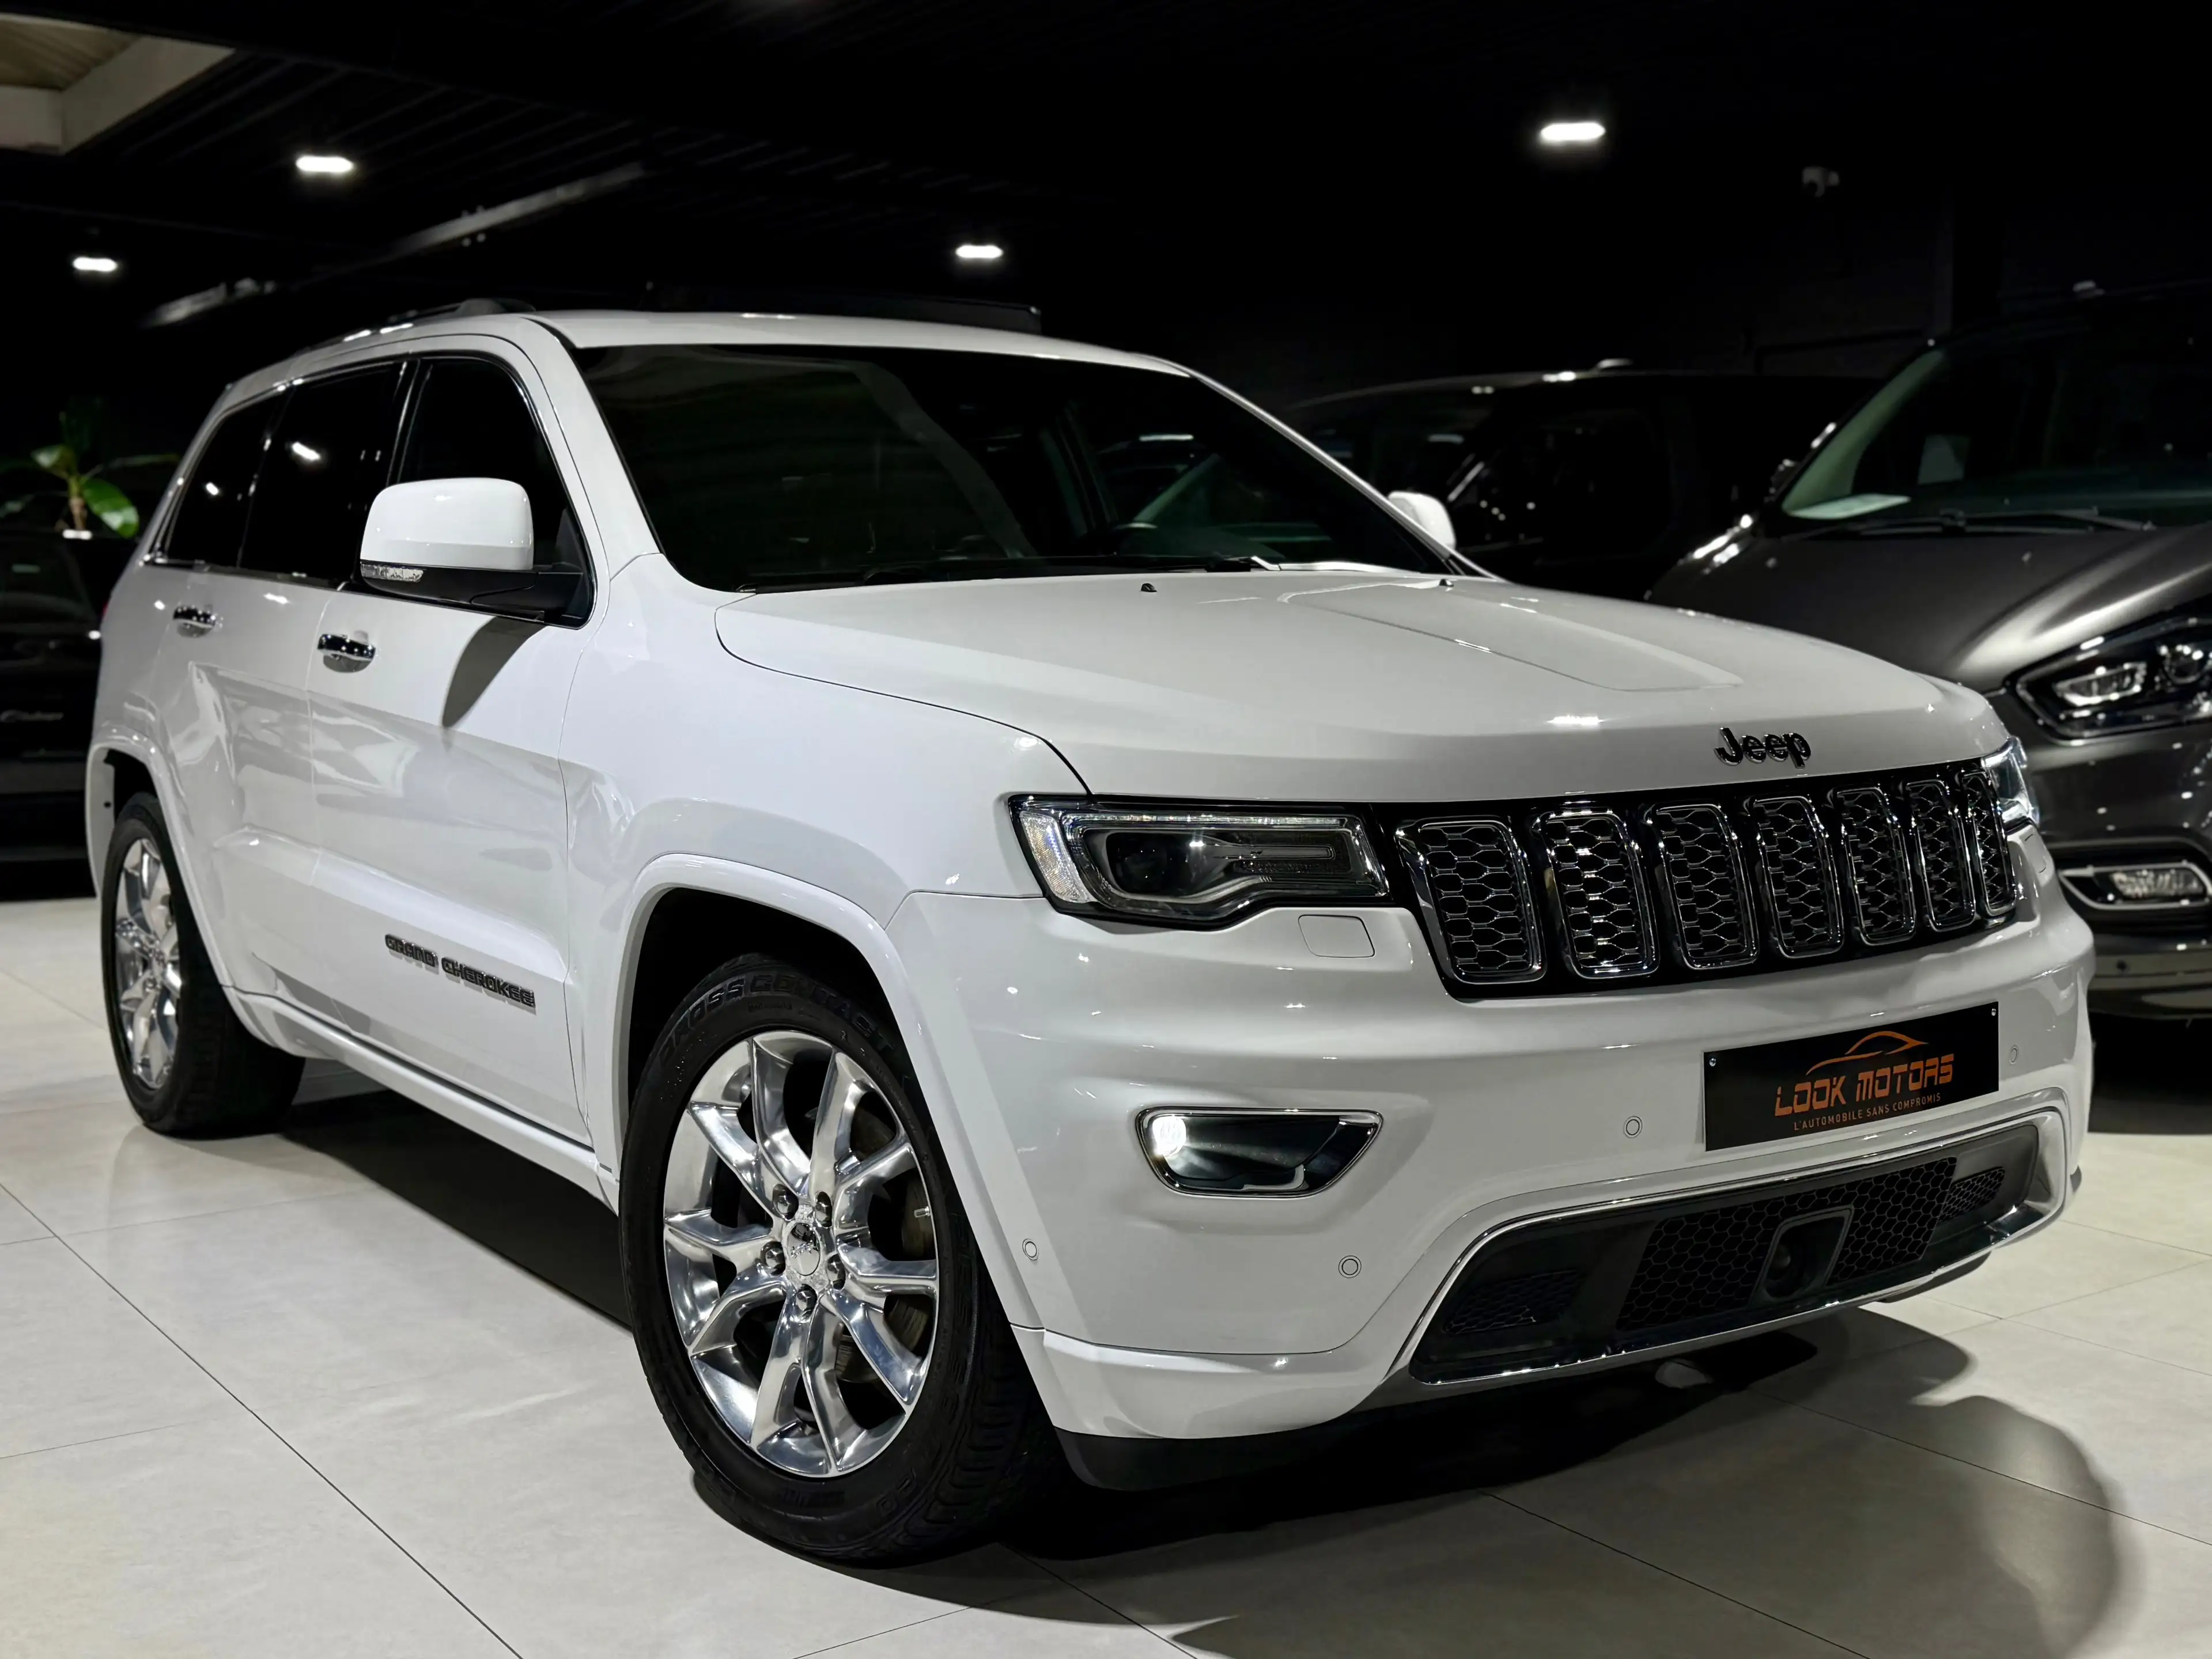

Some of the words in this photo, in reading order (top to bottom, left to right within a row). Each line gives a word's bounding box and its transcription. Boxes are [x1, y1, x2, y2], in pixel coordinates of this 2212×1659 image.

[1714, 727, 1811, 769] Jeep
[385, 934, 438, 967] GRAND
[441, 957, 536, 1008] CHEROKEE
[1775, 1075, 1847, 1116] LOOK
[1855, 1053, 1954, 1102] MOTORS
[1794, 1109, 1863, 1131] L'AUTOMOBILE
[1866, 1103, 1890, 1118] SANS
[1892, 1092, 1942, 1112] COMPROMIS
